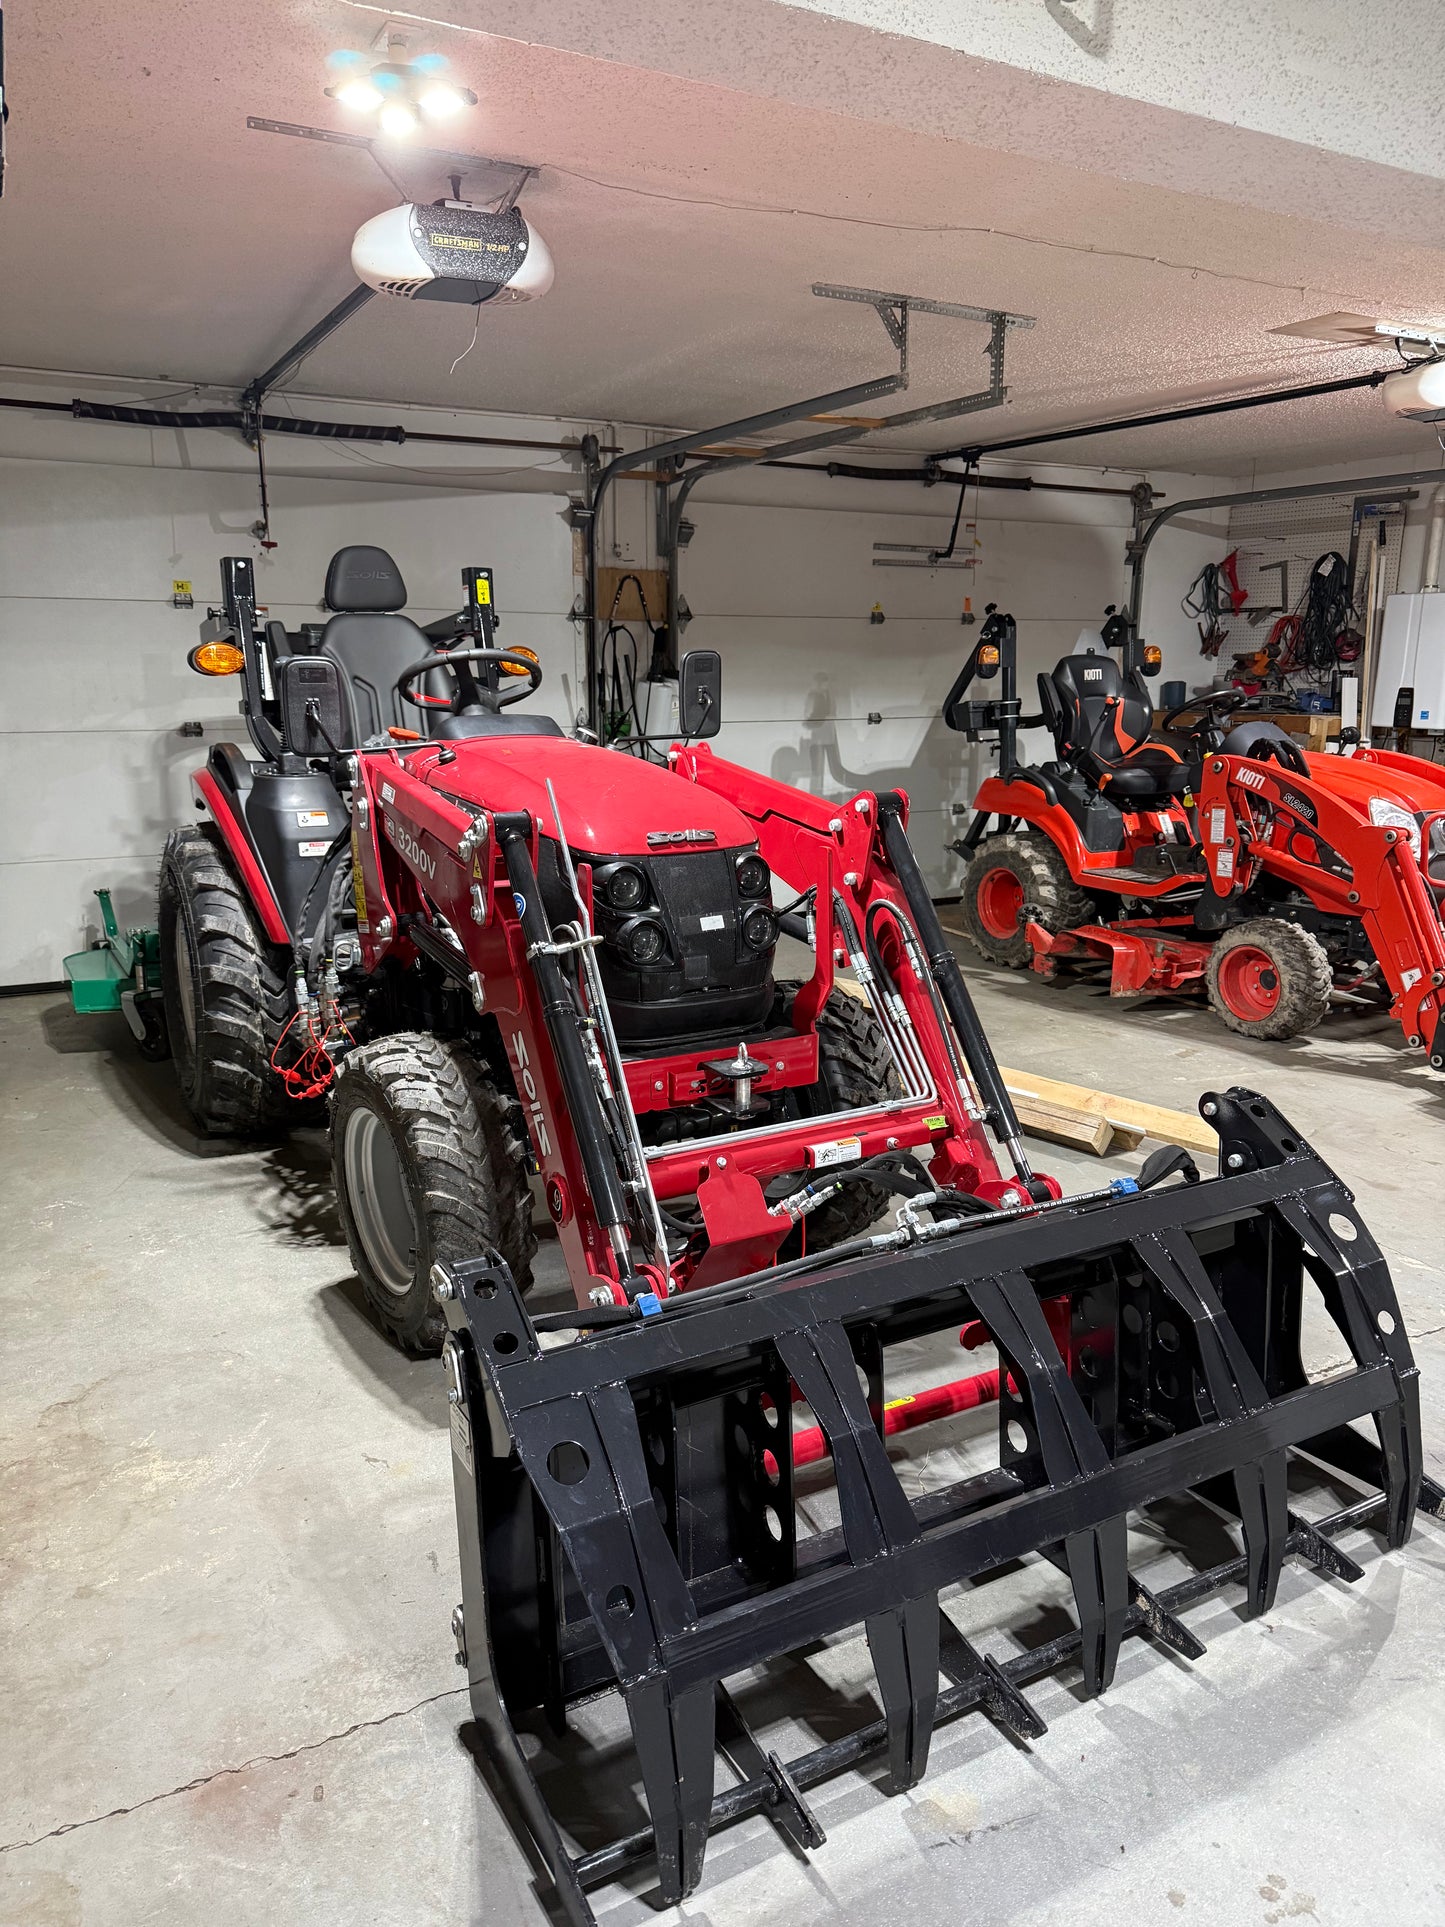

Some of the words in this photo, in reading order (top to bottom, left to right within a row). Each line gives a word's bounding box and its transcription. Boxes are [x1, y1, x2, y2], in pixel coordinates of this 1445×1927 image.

[434, 236, 480, 248] CRAFTSMAN
[1083, 668, 1103, 681] KIOTI
[1235, 767, 1266, 790] KIOTI
[1282, 792, 1315, 820] SL2420
[398, 827, 436, 880] 3200V
[512, 1030, 552, 1157] SOLIS
